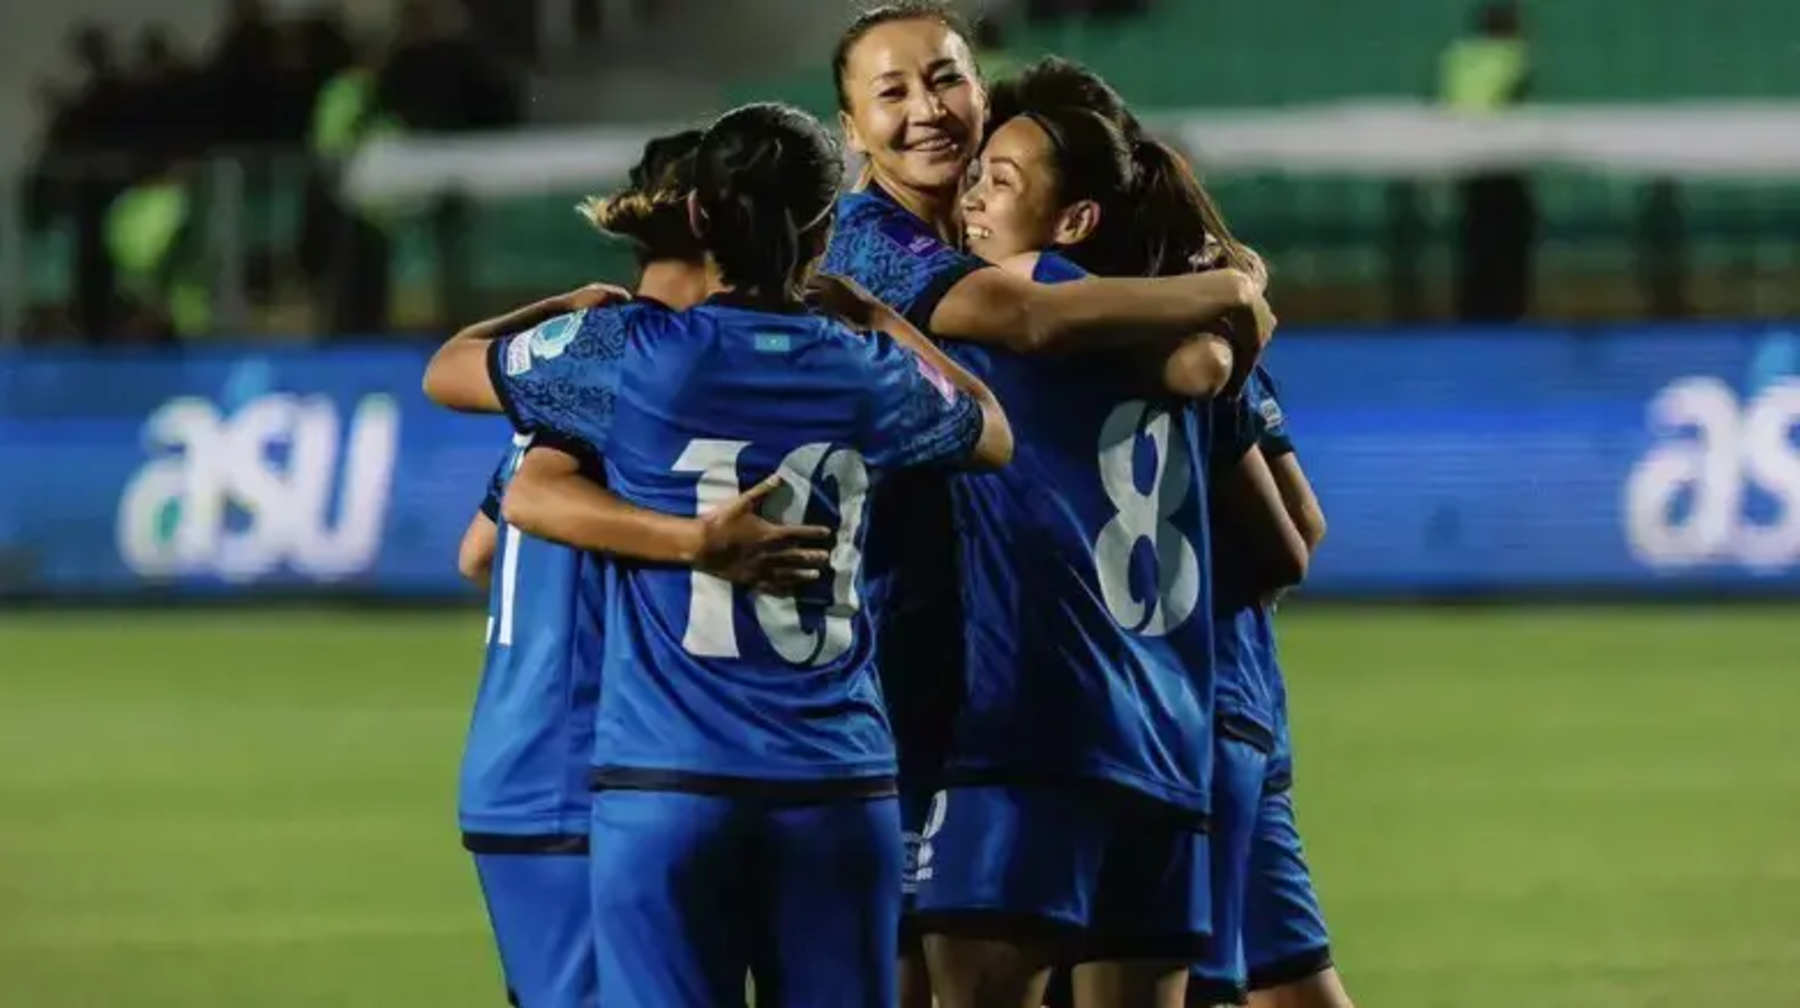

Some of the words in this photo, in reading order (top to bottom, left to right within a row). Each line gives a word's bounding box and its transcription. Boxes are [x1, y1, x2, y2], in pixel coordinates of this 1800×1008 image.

[486, 432, 534, 646] 1
[671, 438, 869, 667] 10
[1094, 400, 1200, 637] 8
